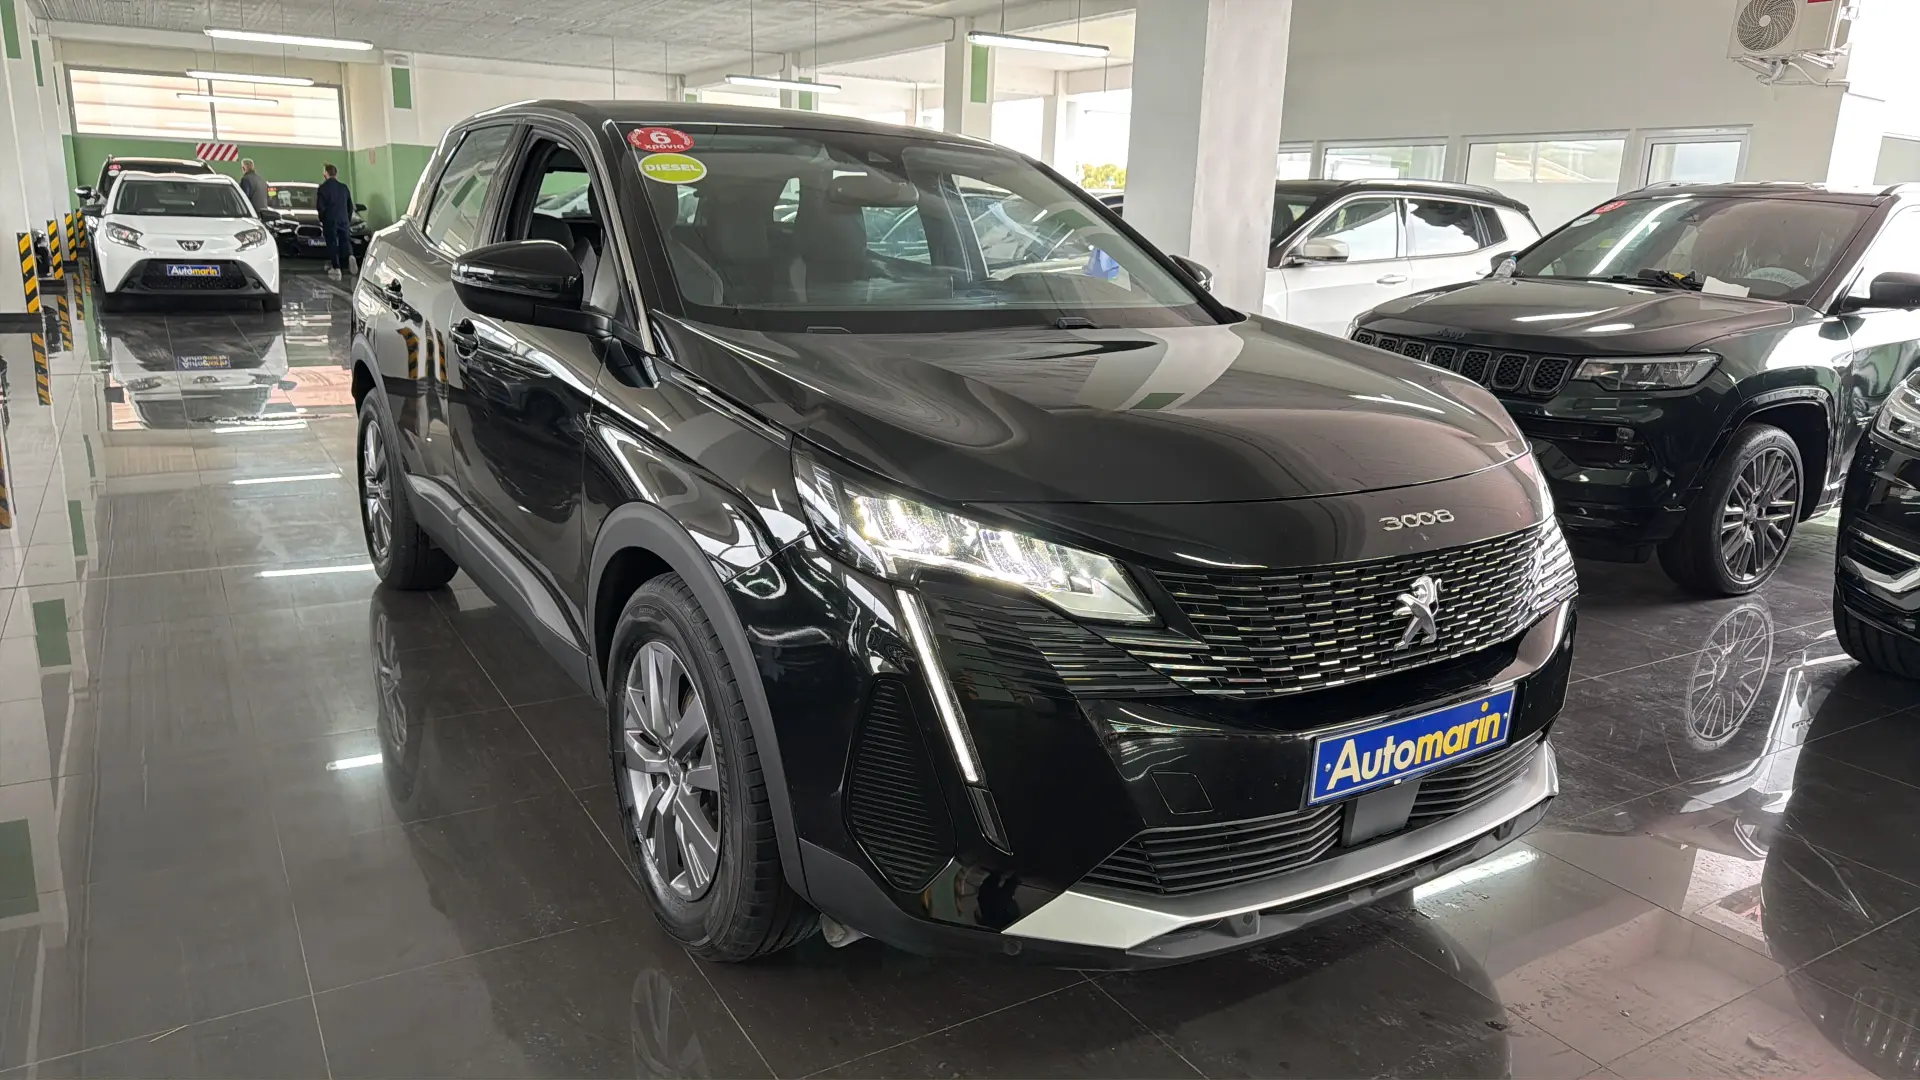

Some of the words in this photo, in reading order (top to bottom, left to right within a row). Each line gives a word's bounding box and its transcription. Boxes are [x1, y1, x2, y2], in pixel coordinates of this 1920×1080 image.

[650, 132, 671, 144] 6
[645, 163, 701, 172] DIESEL
[170, 264, 218, 276] Automarin
[1377, 508, 1455, 531] 3008
[1326, 702, 1501, 790] Automarin
